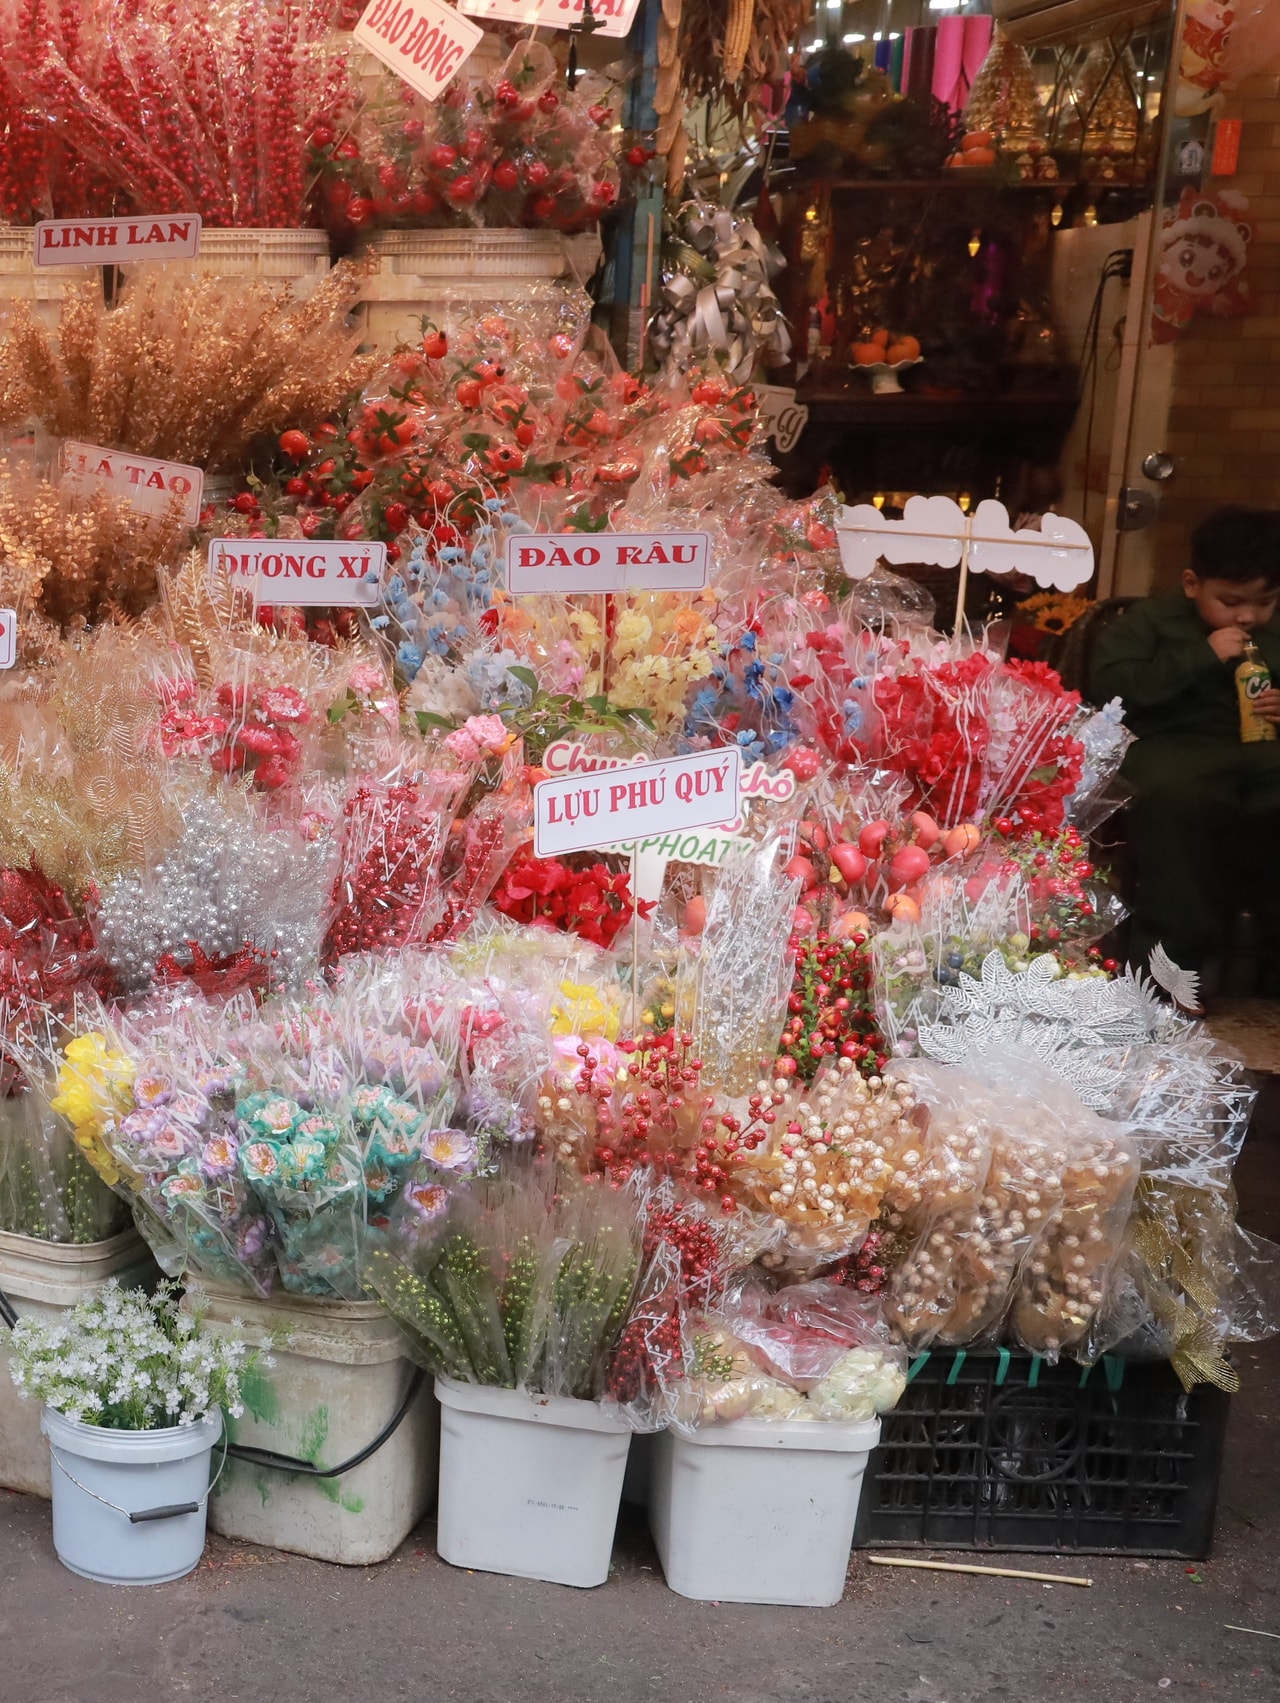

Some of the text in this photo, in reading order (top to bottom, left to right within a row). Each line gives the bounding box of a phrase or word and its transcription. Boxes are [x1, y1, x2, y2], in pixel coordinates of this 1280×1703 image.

[400, 19, 464, 82] ĐÔNG
[43, 222, 191, 248] LINH LAN
[125, 464, 192, 495] TÁO
[336, 548, 372, 578] XỈ
[518, 541, 699, 568] ĐÀO RÂU
[547, 757, 730, 826] LỰU PHÚ QUÝ
